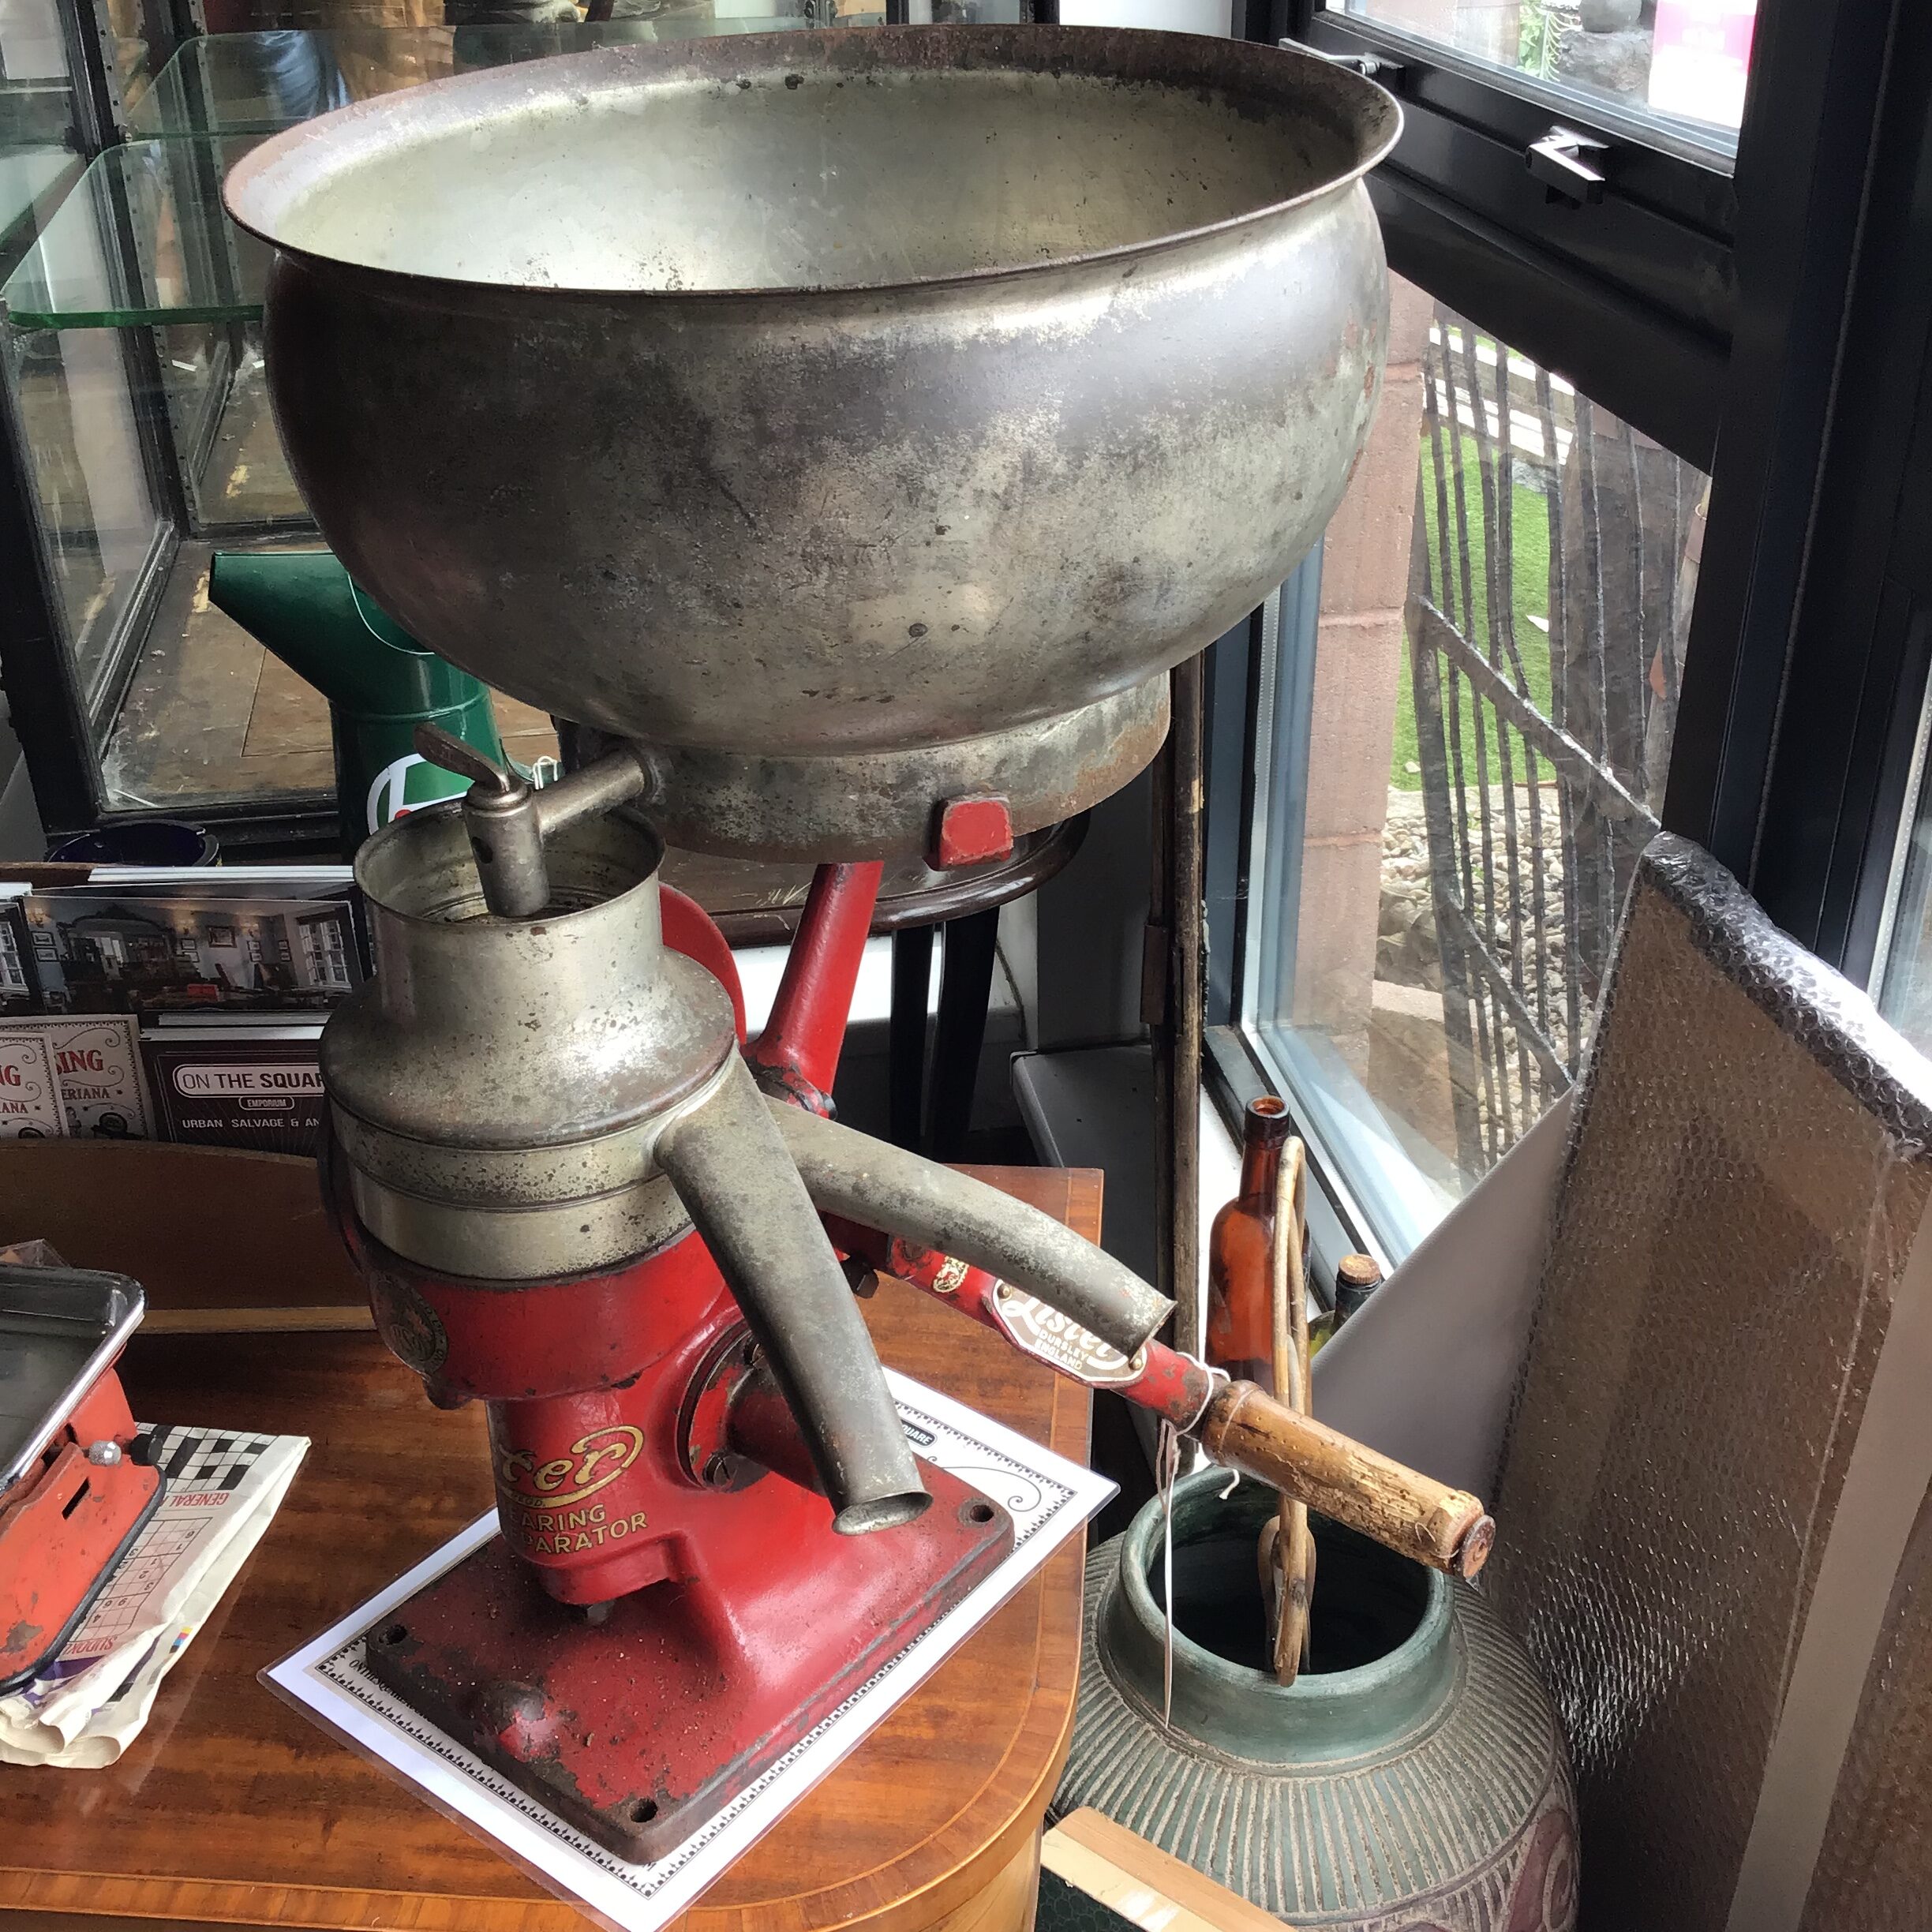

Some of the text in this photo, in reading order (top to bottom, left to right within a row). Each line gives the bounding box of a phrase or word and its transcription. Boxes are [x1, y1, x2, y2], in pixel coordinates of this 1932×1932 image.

[182, 1073, 210, 1089] ON
[214, 1073, 255, 1088] THE
[246, 1098, 286, 1107] EMPORIUM
[182, 1119, 223, 1129] URBAN
[230, 1118, 285, 1128] SALVAGE
[290, 1118, 299, 1127] &
[1039, 1328, 1090, 1361] DURSLEY
[1034, 1338, 1084, 1371] ENGLAND
[169, 1492, 230, 1507] GENERAL
